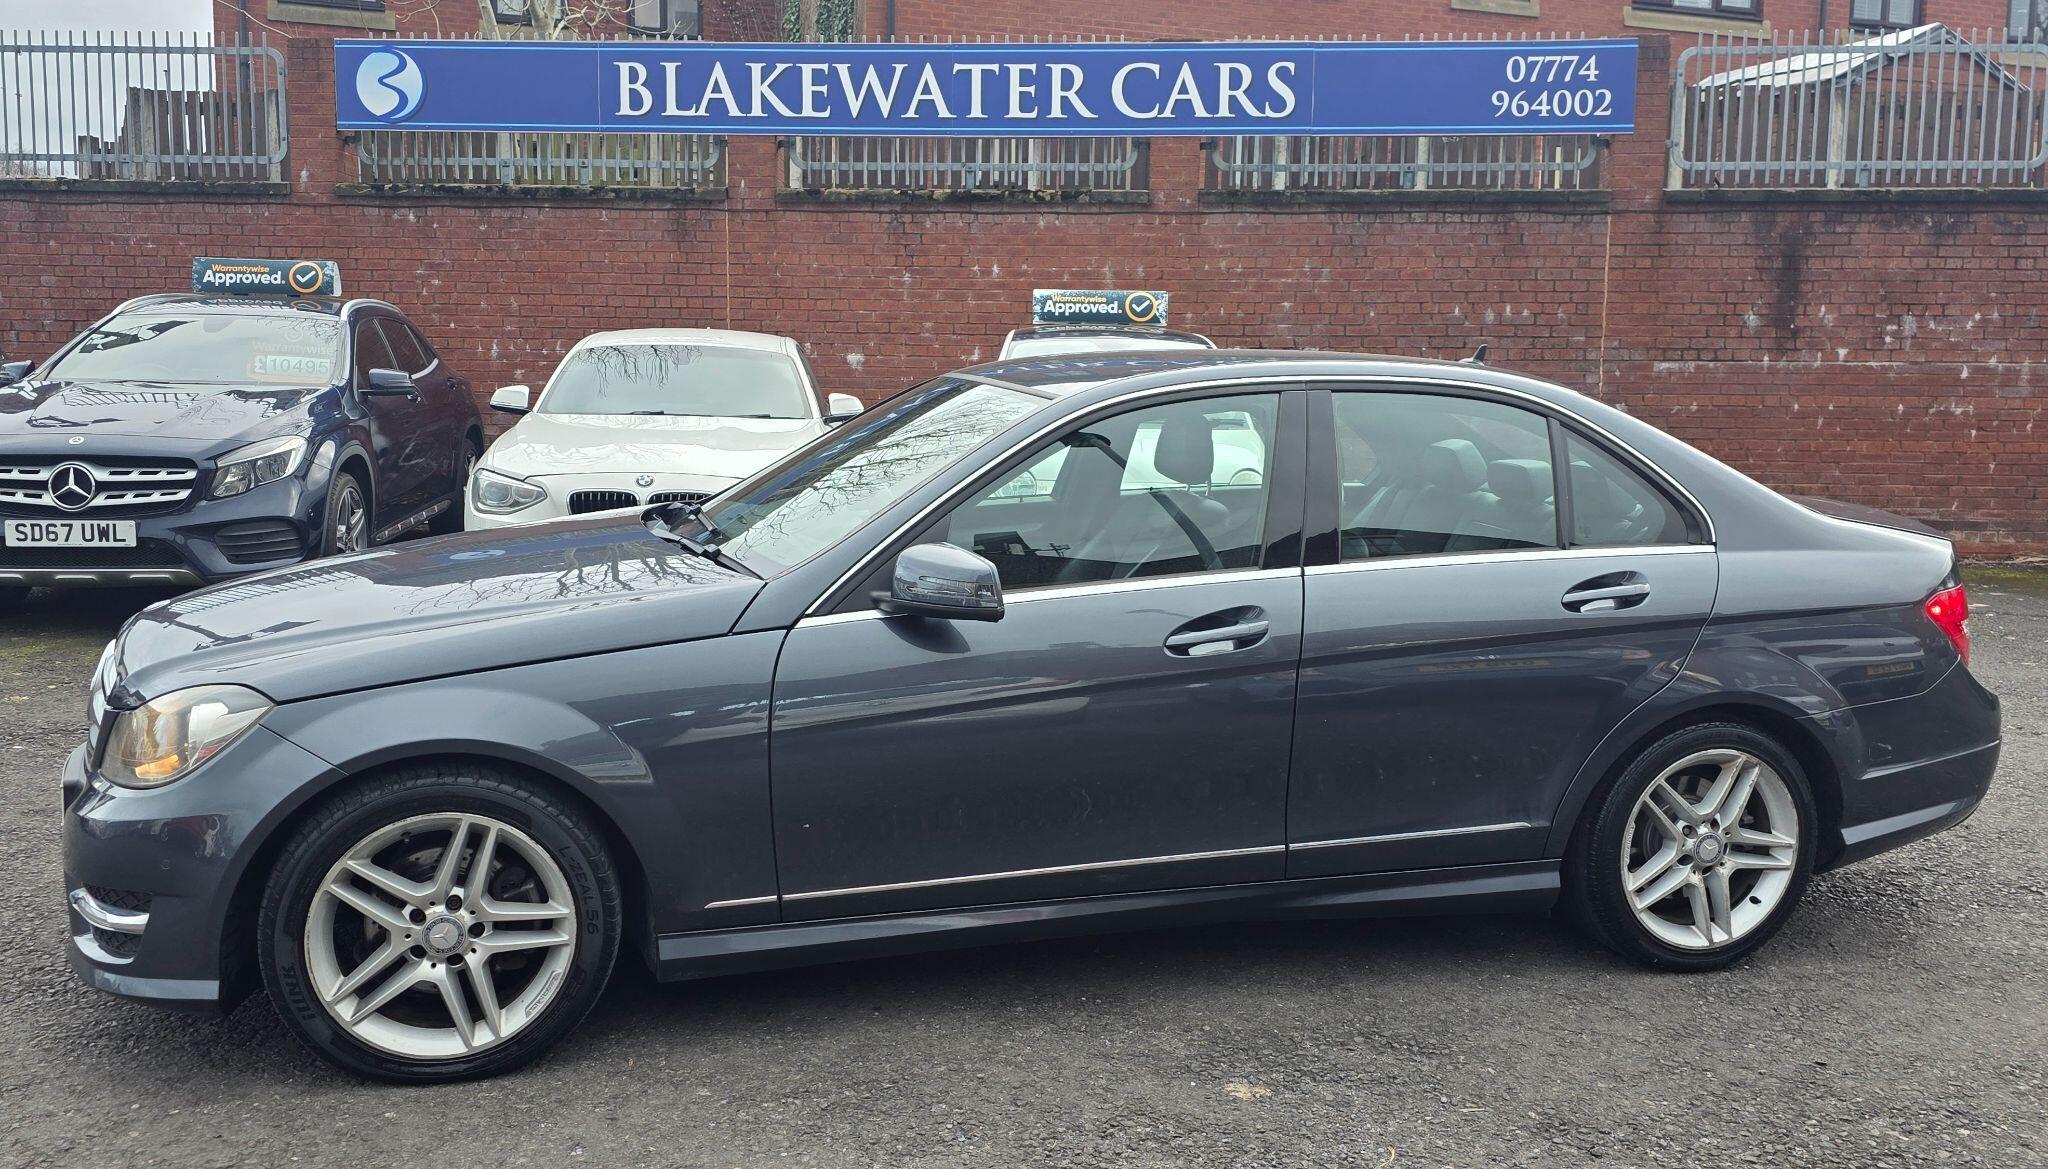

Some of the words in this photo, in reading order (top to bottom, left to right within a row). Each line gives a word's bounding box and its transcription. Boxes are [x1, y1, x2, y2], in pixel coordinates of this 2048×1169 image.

[1505, 54, 1600, 83] 07774
[614, 60, 1099, 120] BLAKEWATER
[1110, 60, 1298, 120] CARS
[1490, 89, 1613, 119] 964002
[211, 263, 270, 274] Warrantywise
[1043, 299, 1123, 316] Approved.
[1051, 294, 1107, 304] Warrantywise
[14, 523, 74, 543] SD67
[80, 523, 127, 543] UWL
